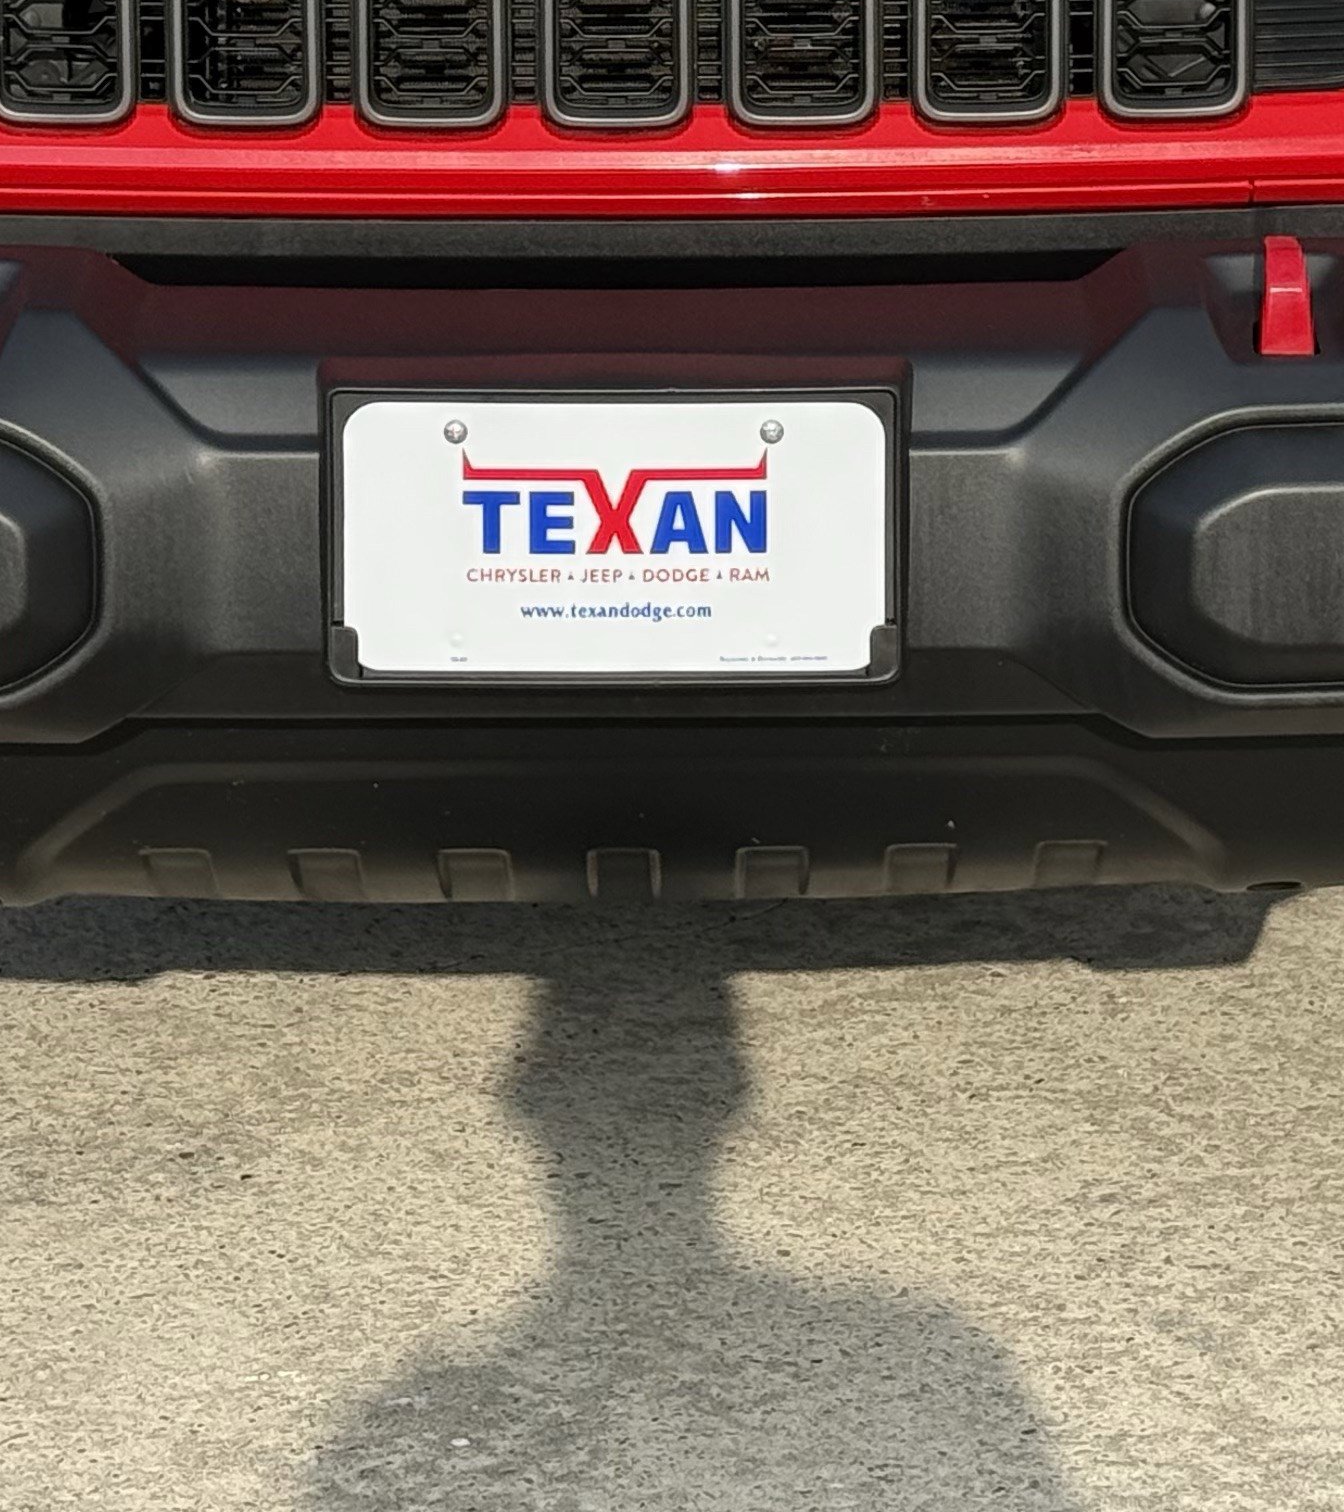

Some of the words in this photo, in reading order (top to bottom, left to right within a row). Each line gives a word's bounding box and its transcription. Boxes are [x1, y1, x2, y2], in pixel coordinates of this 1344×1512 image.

[462, 468, 768, 555] TEXAN
[466, 567, 561, 583] CHRYSLER
[580, 568, 623, 583] JEEP
[642, 568, 710, 583] DODGE
[728, 567, 770, 583] RAM
[520, 602, 712, 622] www.texandodge.com
